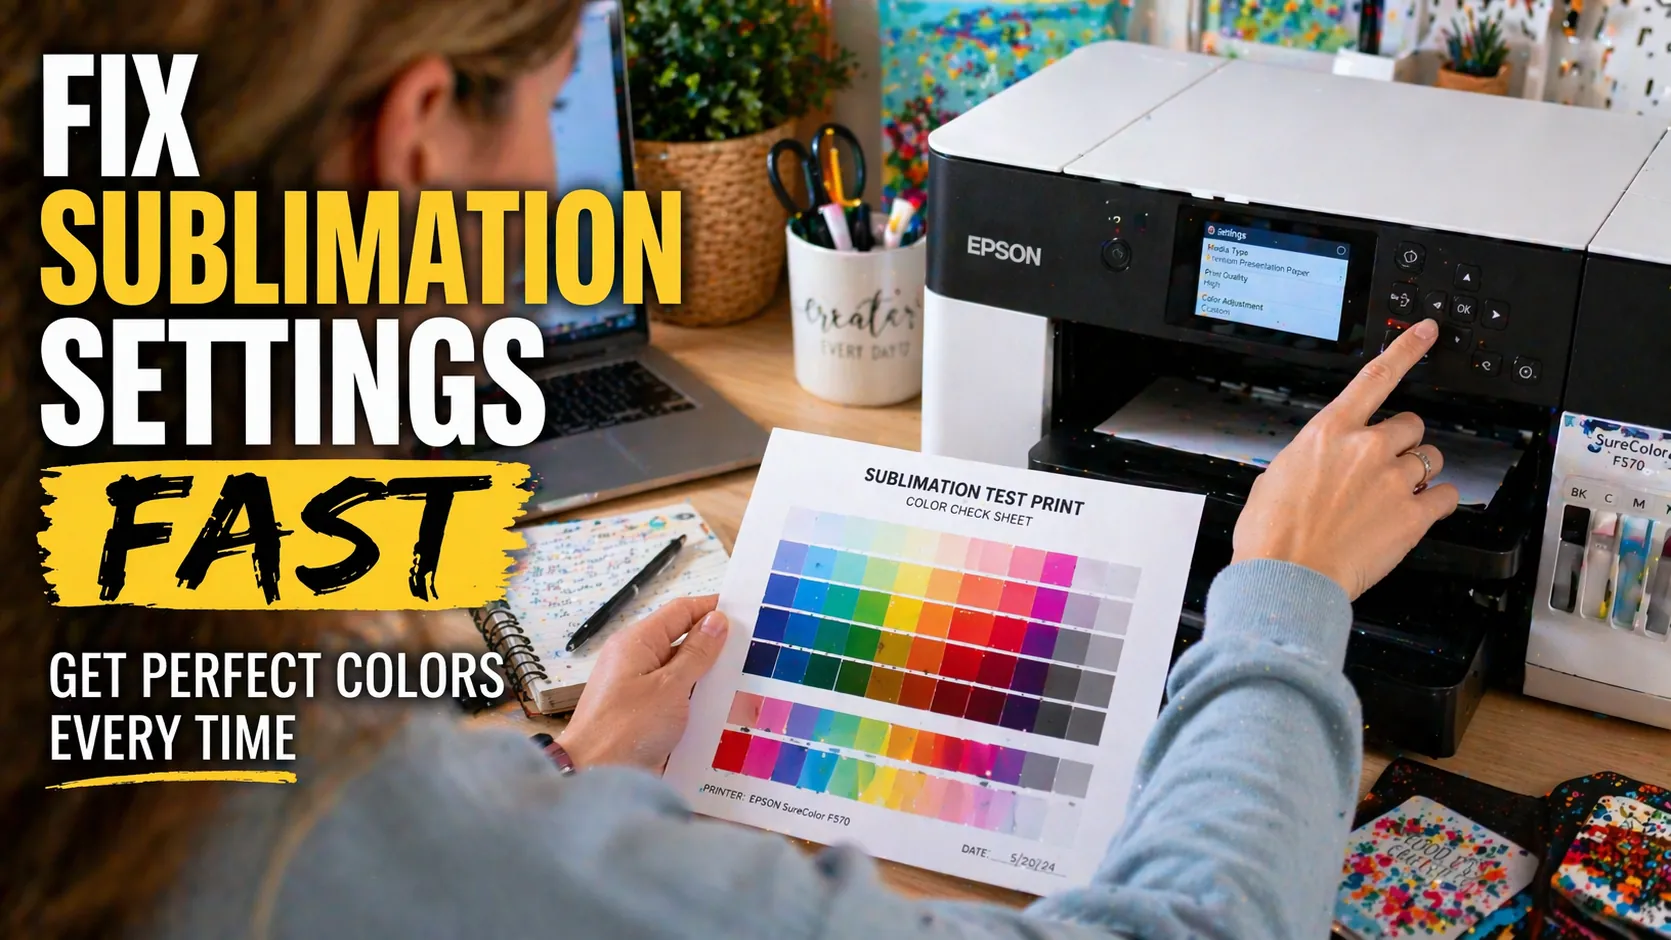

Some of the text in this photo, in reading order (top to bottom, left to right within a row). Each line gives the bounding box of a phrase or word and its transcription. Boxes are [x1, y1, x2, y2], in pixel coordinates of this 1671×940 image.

[967, 235, 1042, 267] EPSON
[1223, 271, 1248, 284] Quality
[1202, 294, 1264, 311] Color Adjustment
[1457, 303, 1472, 315] OK
[821, 340, 863, 361] EVERY
[1595, 433, 1669, 458] SureColor
[1612, 455, 1646, 471] F570
[864, 467, 1085, 516] SUBLIMATION TEST PRINT
[1571, 487, 1646, 509] BK C M
[905, 496, 1034, 527] COLOR CHECK SHEET
[702, 783, 851, 827] PRINTER: EPSON SureColor F570
[1010, 852, 1056, 872] 5/20/24
